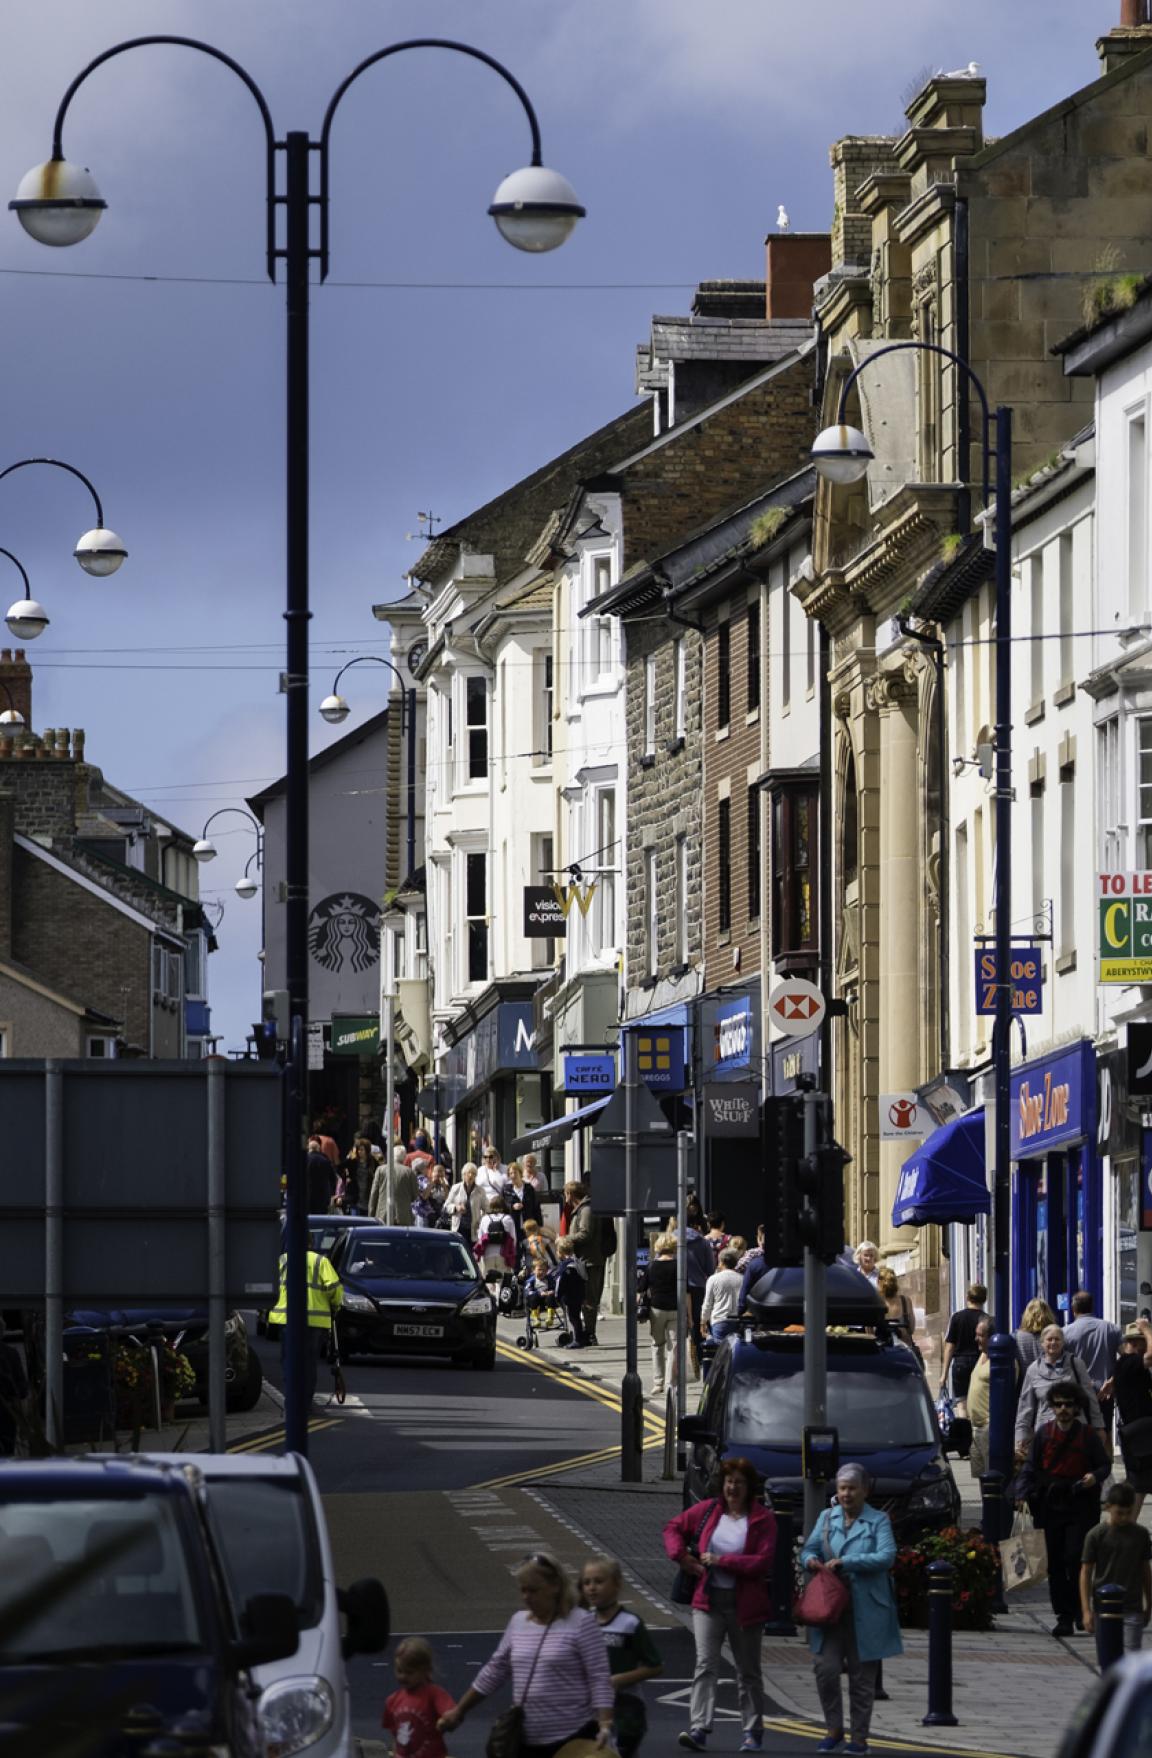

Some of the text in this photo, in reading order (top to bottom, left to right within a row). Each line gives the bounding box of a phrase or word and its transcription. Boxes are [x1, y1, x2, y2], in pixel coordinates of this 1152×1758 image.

[1100, 874, 1125, 894] TO
[535, 900, 563, 910] visio
[530, 912, 566, 924] expres
[981, 955, 1036, 980] Soe
[982, 984, 1038, 1009] Zne
[336, 1026, 378, 1047] SUBWAY
[569, 1074, 610, 1083] NERO
[1019, 1072, 1070, 1140] Shoe Zone
